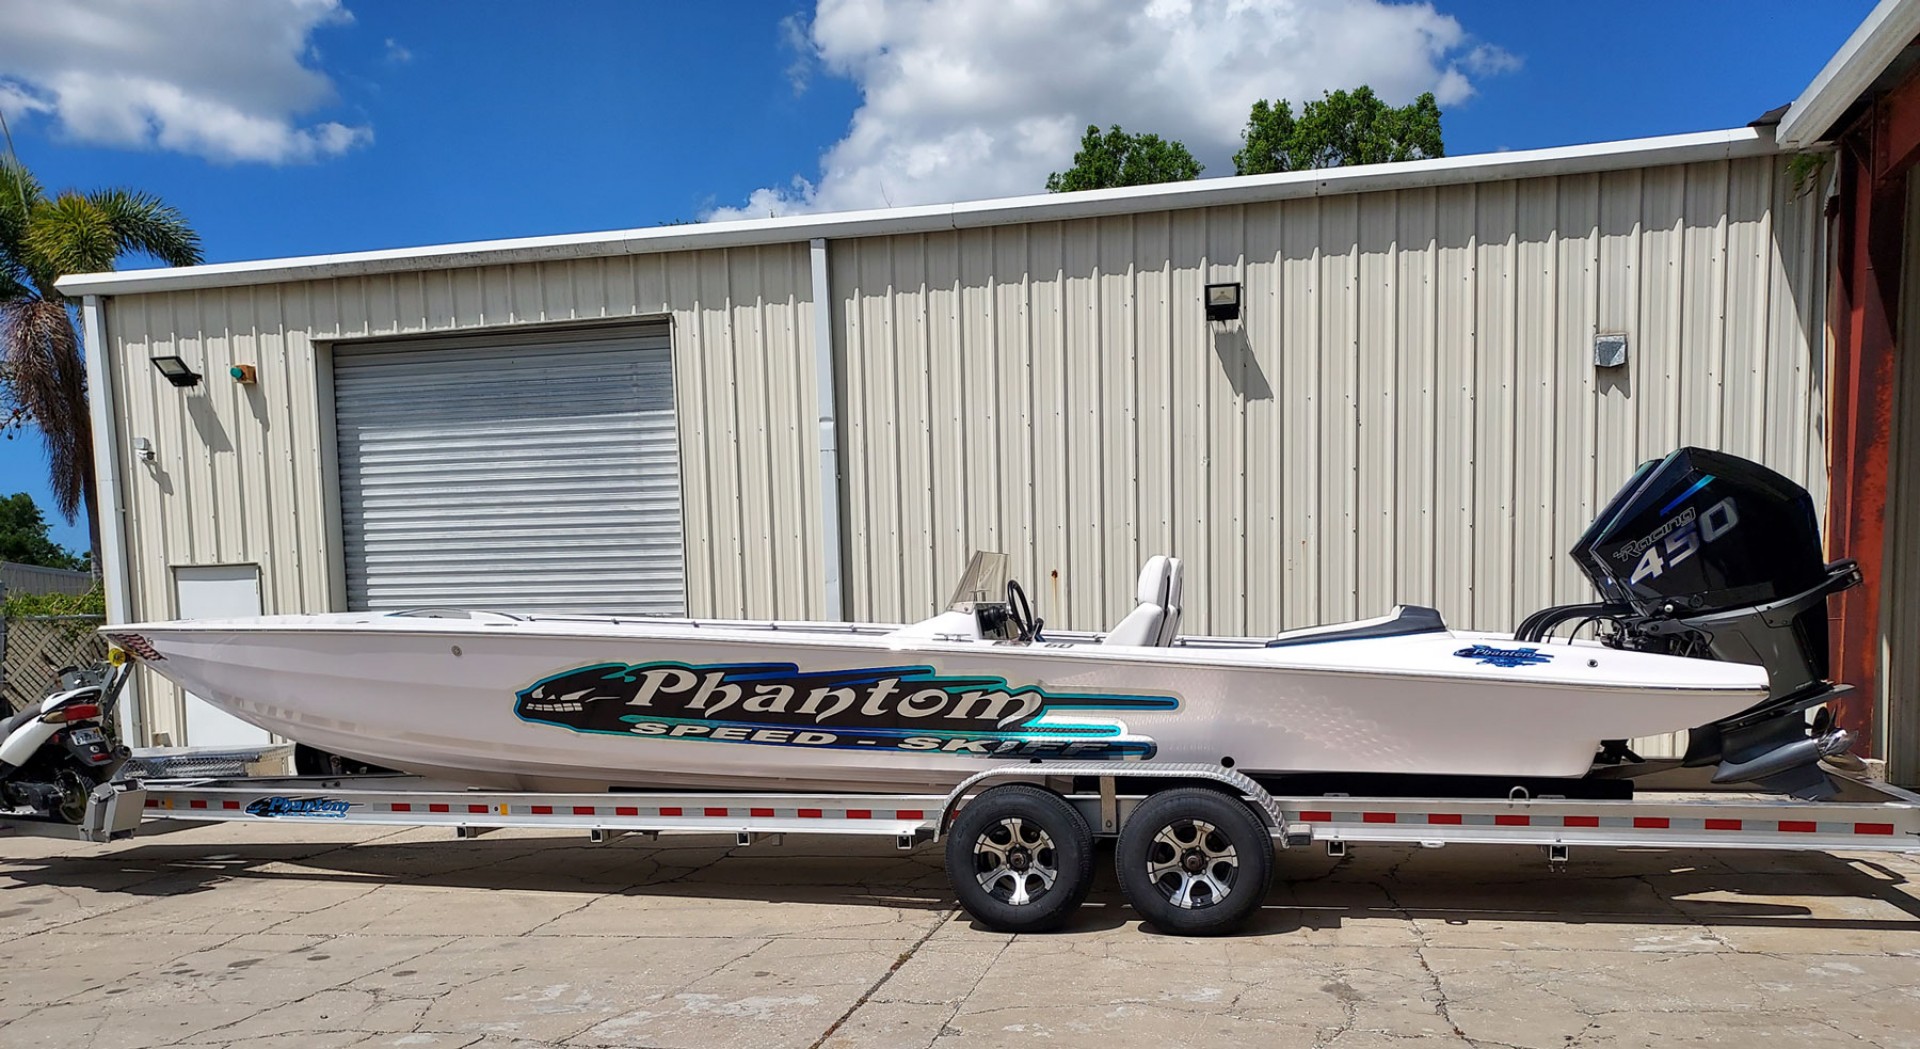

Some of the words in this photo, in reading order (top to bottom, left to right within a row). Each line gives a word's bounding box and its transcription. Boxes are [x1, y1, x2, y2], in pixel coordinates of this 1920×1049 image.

[1614, 507, 1696, 562] Racing
[1630, 496, 1739, 585] 450
[1473, 648, 1536, 658] Phantom
[625, 668, 1042, 729] Phantom
[630, 722, 838, 746] SPEED
[897, 736, 1109, 756] SKIFF
[268, 796, 351, 814] Phantom
